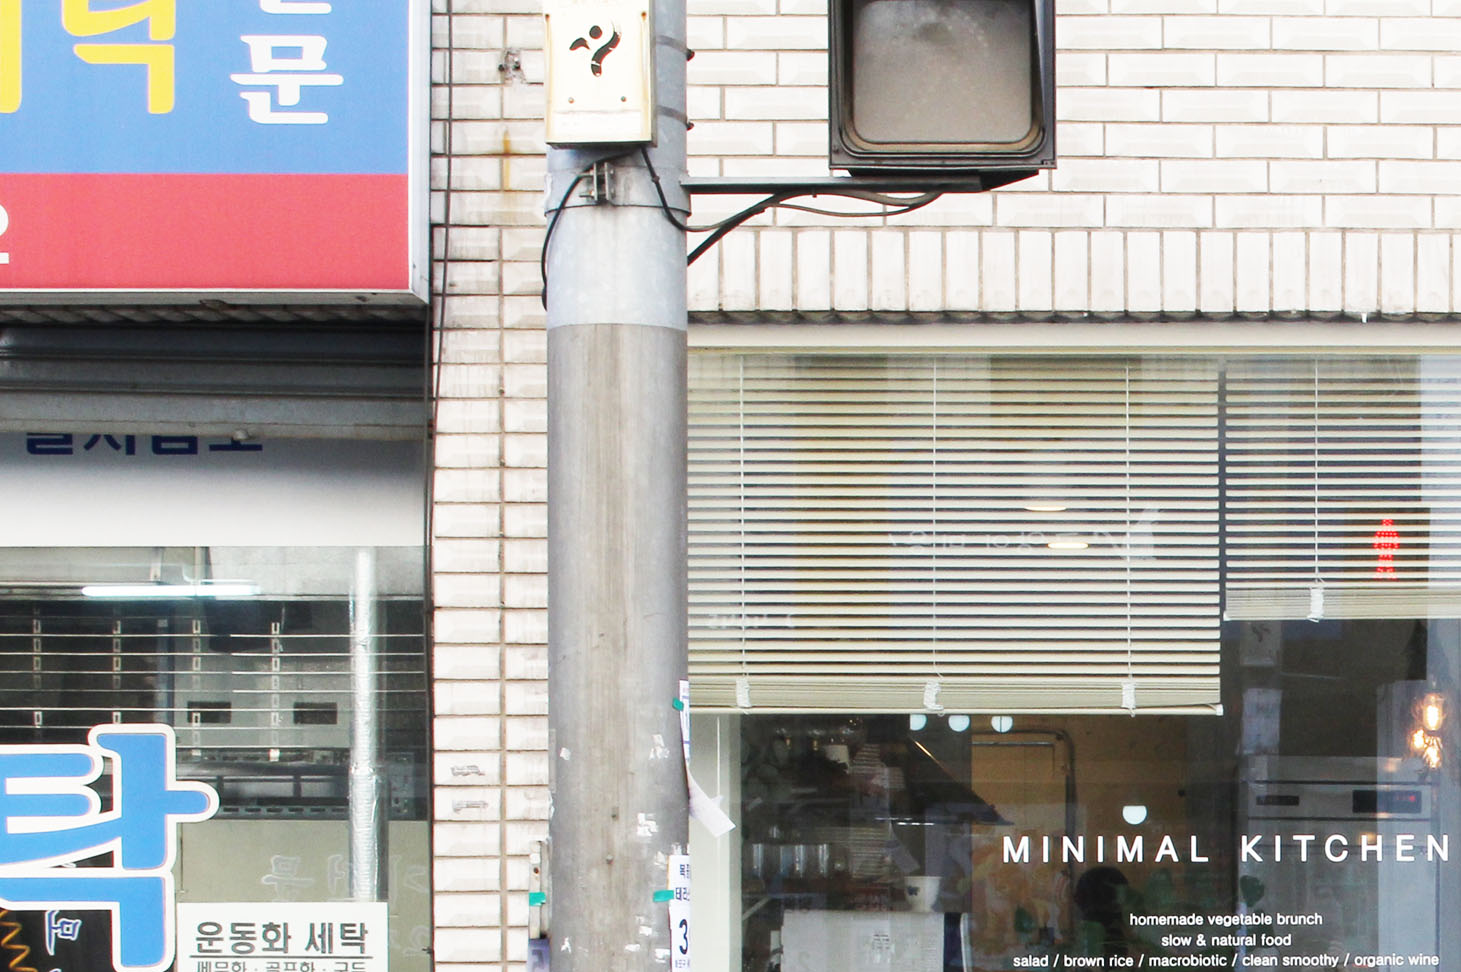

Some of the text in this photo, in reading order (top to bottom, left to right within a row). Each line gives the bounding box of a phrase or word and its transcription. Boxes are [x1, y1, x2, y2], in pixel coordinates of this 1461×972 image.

[1002, 834, 1452, 863] MINIMAL KITCHEN
[1129, 912, 1323, 928] homemade vegetable brunch
[194, 921, 369, 955] 운동화 세탁
[1161, 933, 1292, 947] slow & natural food
[1013, 954, 1049, 967] salad
[1063, 954, 1105, 967] brown
[1109, 954, 1134, 967] rice
[1148, 953, 1228, 967] macrobiotic
[1241, 953, 1278, 967] clean
[1282, 954, 1340, 970] smoothy
[1353, 953, 1403, 970] organic
[1407, 953, 1441, 967] wine
